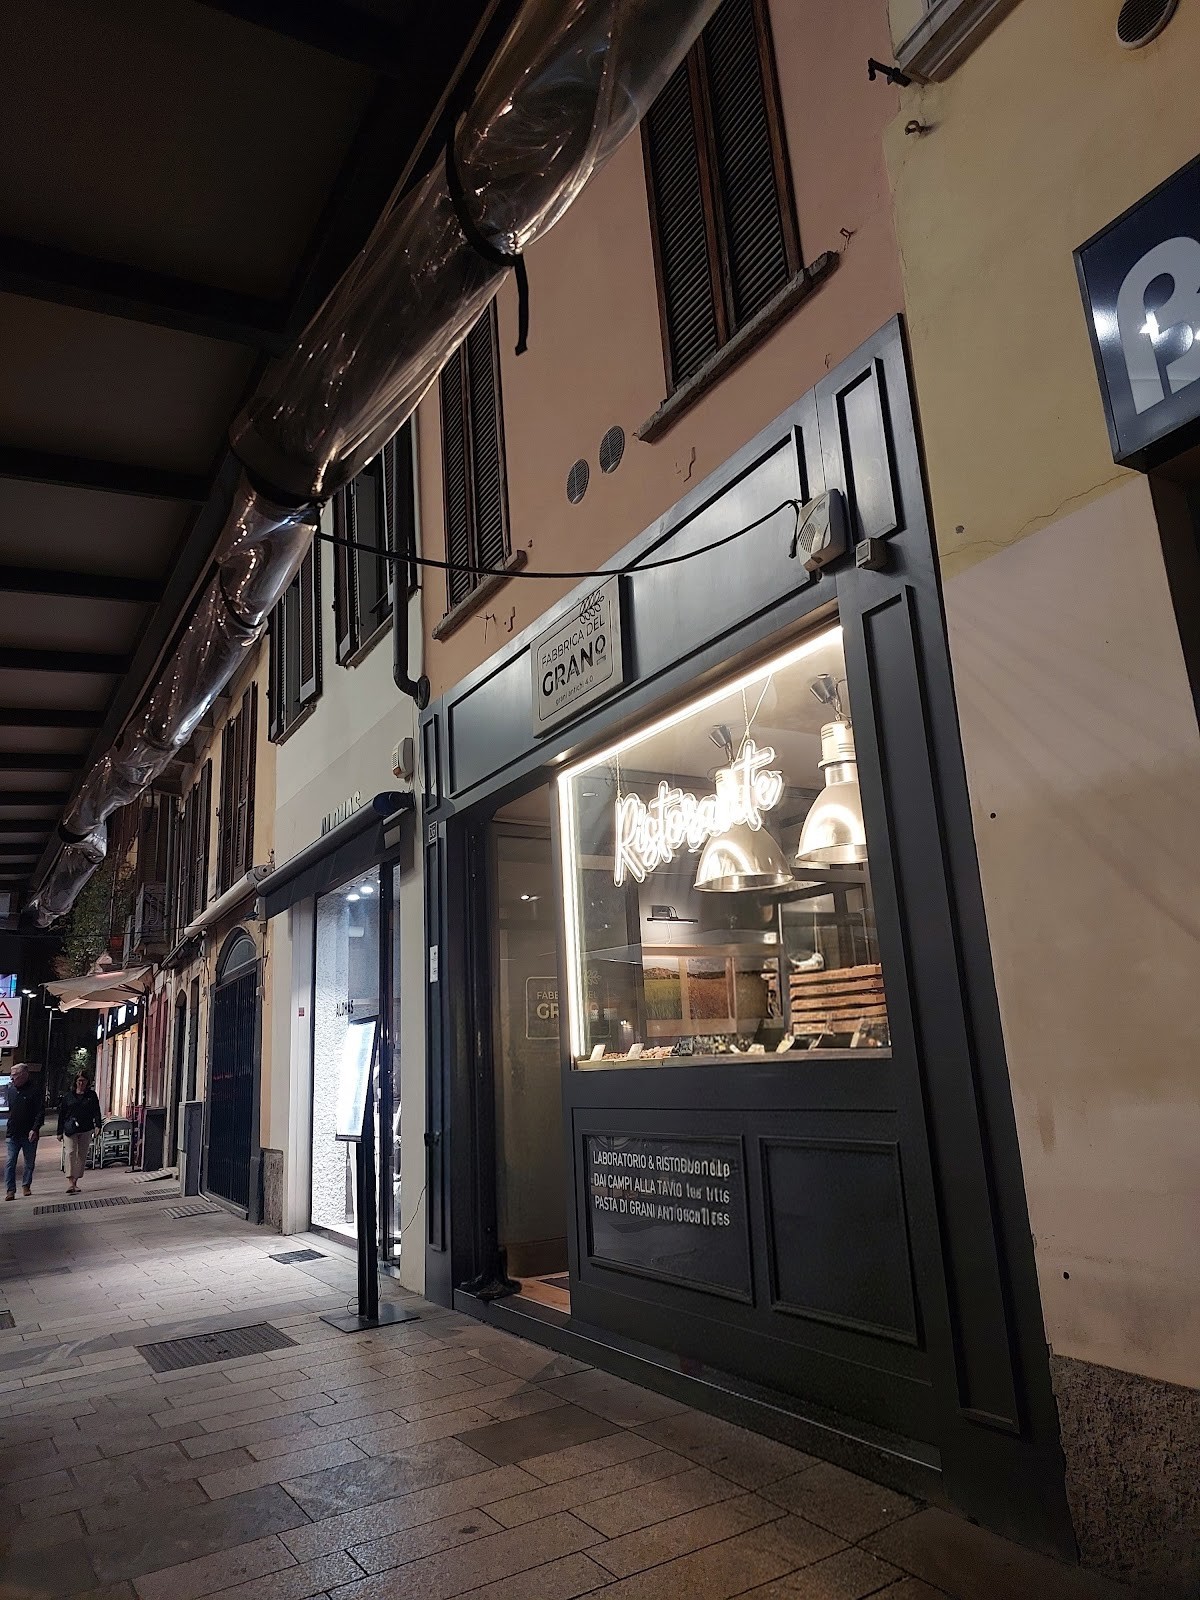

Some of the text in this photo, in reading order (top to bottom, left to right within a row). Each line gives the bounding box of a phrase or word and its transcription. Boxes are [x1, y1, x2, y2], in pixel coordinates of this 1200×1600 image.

[541, 614, 605, 670] FABBRICA DEL
[542, 634, 606, 697] GRANO
[593, 1150, 647, 1169] LABORATORIO
[648, 1154, 655, 1170] &
[593, 1172, 607, 1188] DAI
[607, 1174, 633, 1191] CAMPI
[634, 1177, 657, 1195] ALLA
[594, 1195, 619, 1212] PASTA
[619, 1198, 629, 1214] DI
[629, 1200, 656, 1219] GRANI
